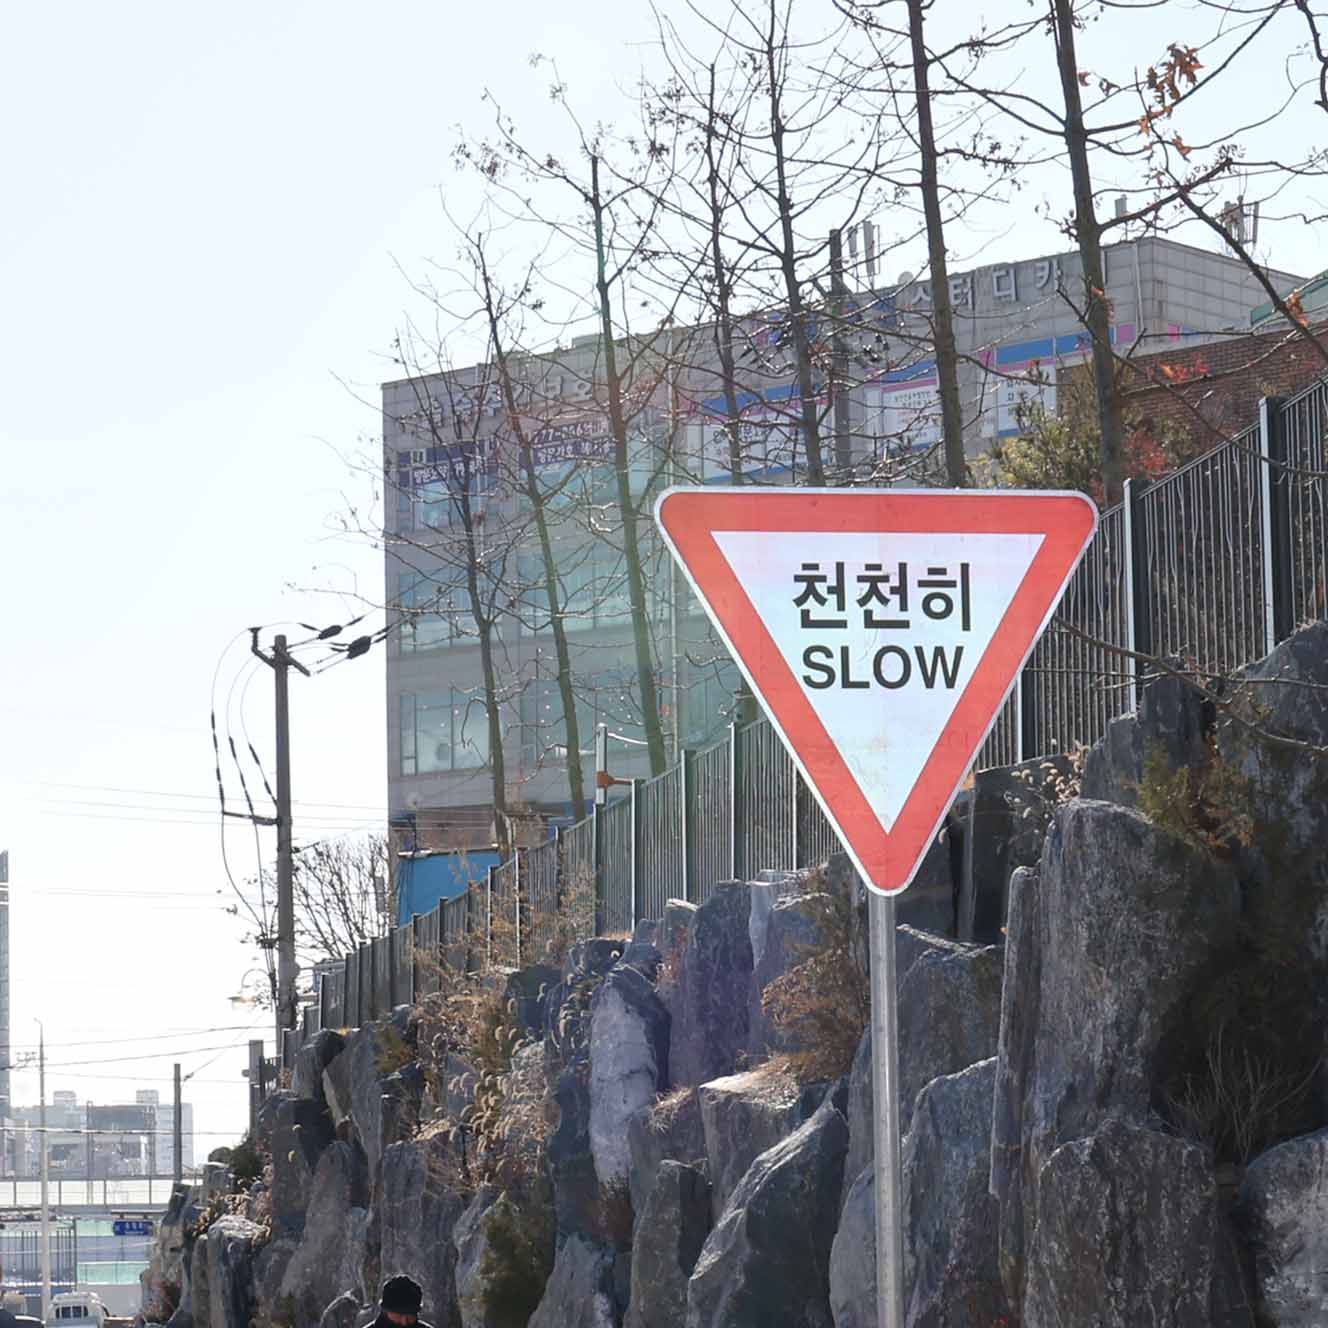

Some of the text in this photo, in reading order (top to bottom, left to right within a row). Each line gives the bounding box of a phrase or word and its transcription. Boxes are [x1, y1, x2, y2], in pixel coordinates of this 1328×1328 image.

[911, 258, 1060, 310] 스터디카
[792, 561, 971, 631] 천천히
[802, 645, 964, 689] SLOW
